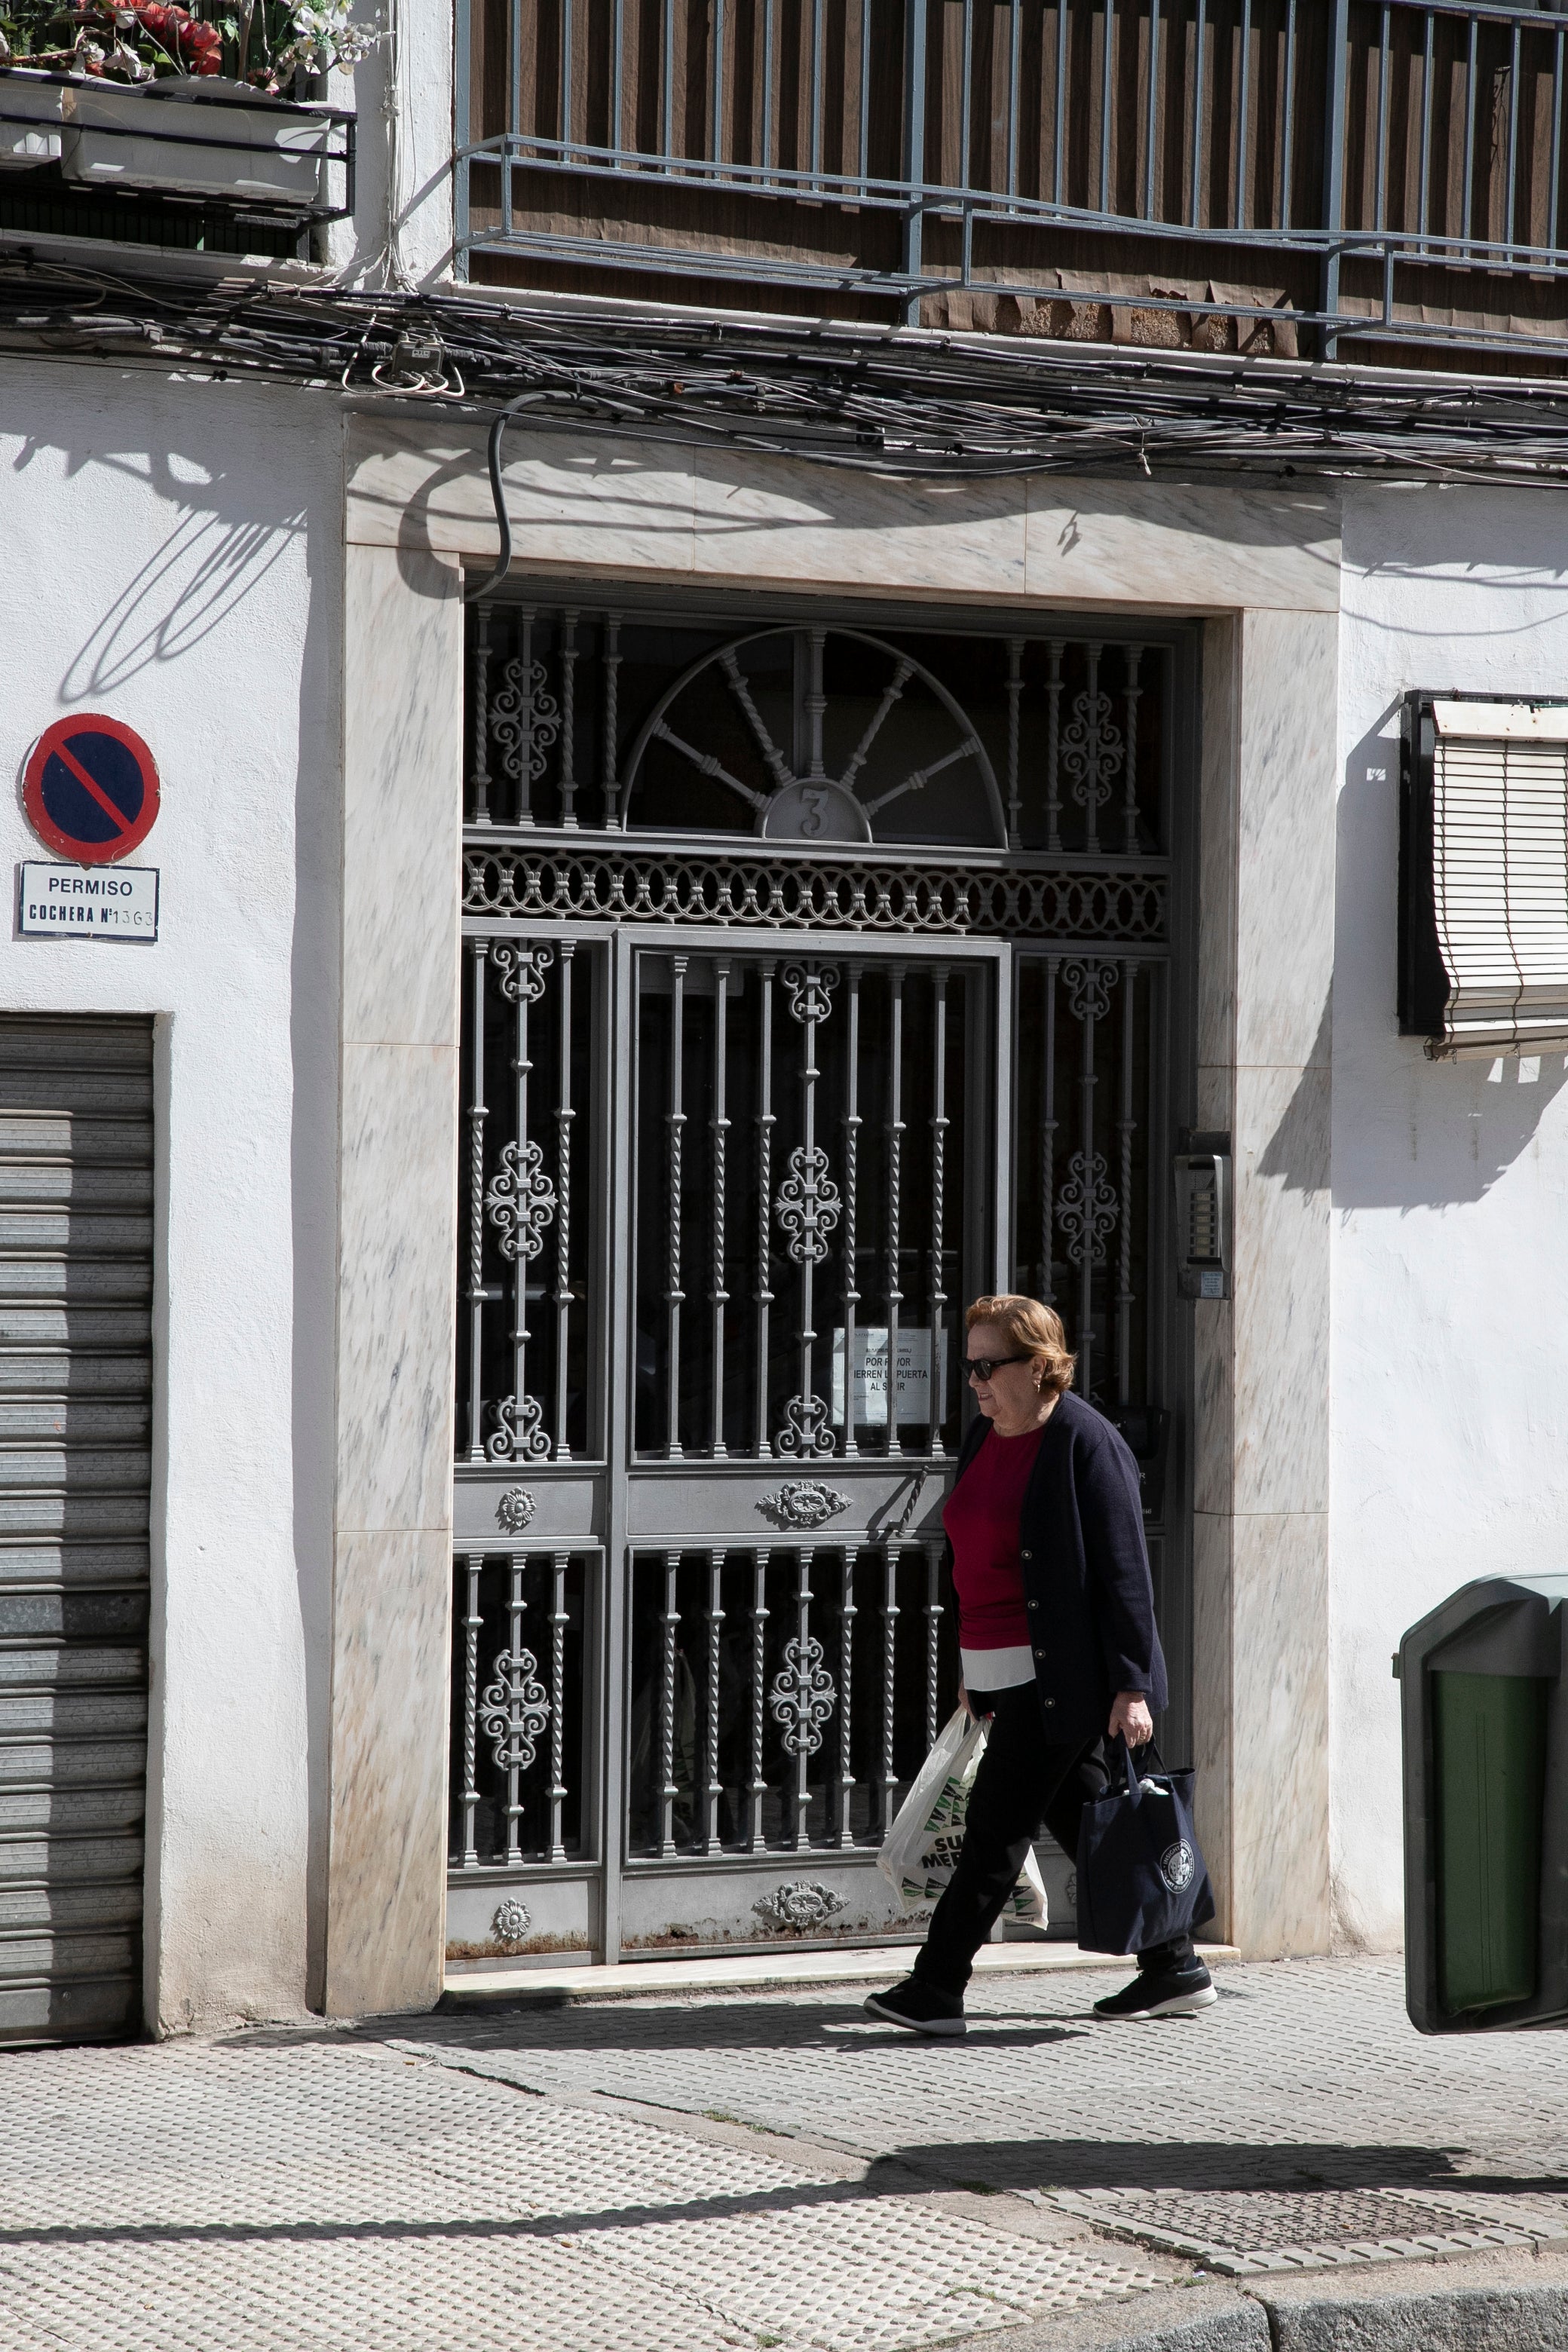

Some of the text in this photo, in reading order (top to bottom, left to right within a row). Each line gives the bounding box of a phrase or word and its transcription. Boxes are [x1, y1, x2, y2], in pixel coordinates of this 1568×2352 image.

[801, 788, 828, 838] 3
[48, 877, 133, 896] PERMISO
[29, 904, 94, 923] COCHERA
[865, 1358, 911, 1367] POR FOR
[853, 1370, 882, 1379] IERREN
[896, 1370, 928, 1379] PUERTA
[870, 1382, 905, 1391] AL SIR
[934, 1833, 965, 1852] SU
[1163, 1845, 1181, 1865] INSIGHT
